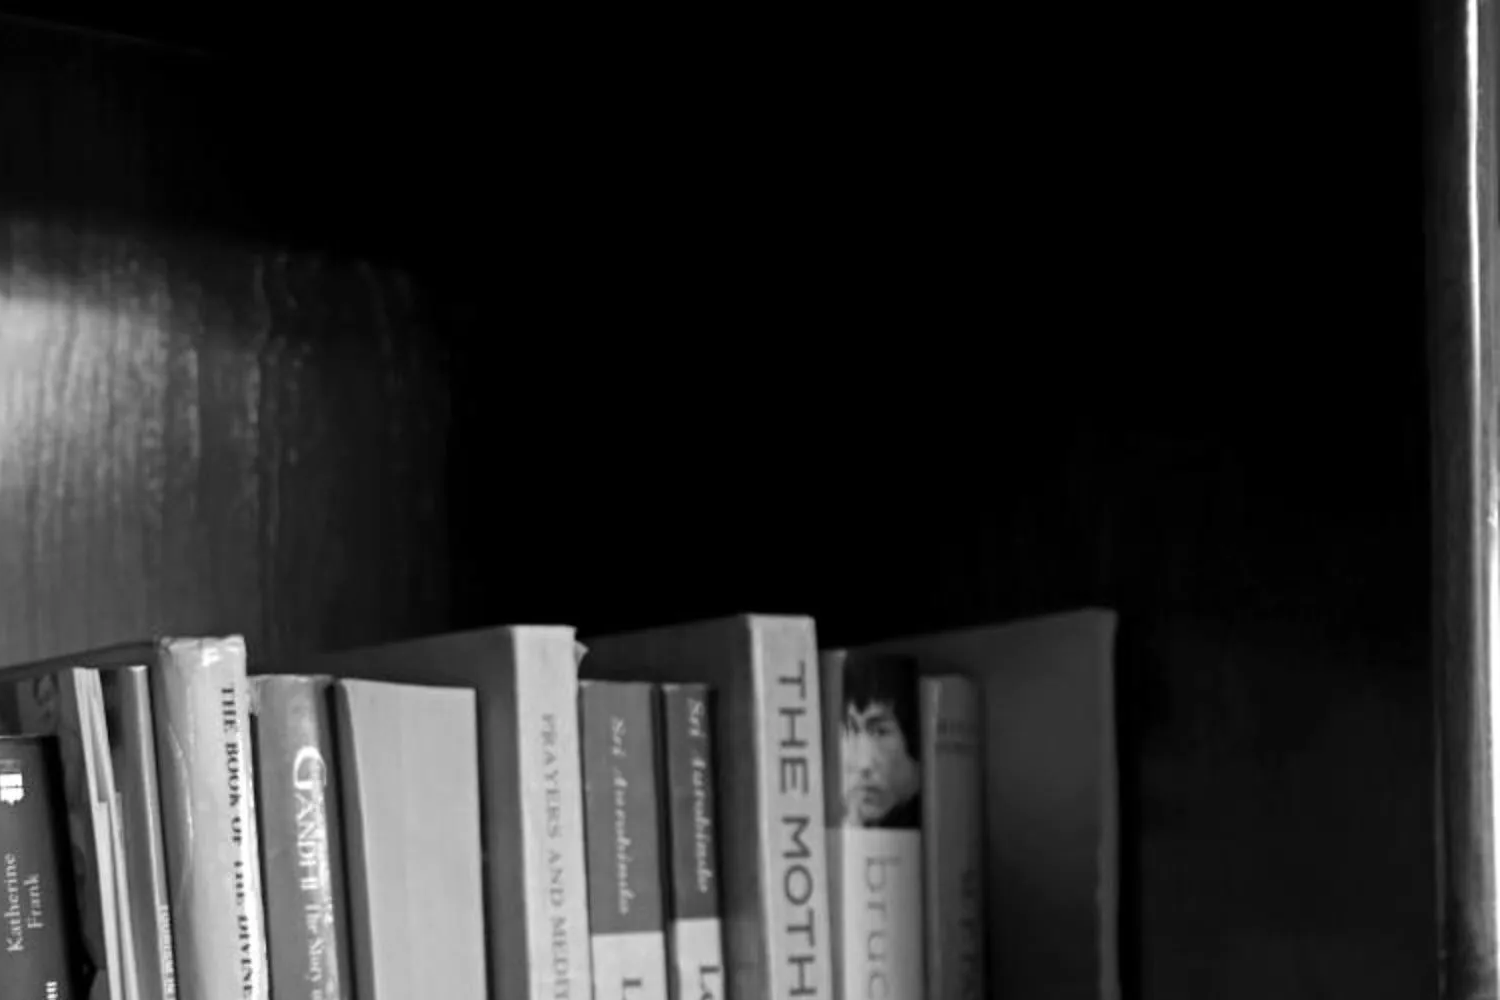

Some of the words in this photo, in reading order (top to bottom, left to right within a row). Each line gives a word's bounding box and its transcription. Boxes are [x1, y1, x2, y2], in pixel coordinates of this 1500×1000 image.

[777, 659, 811, 794] THE
[293, 746, 328, 892] GANDHI
[3, 852, 26, 952] Katherine
[26, 873, 44, 929] Frank
[237, 915, 256, 1000] DIVINE
